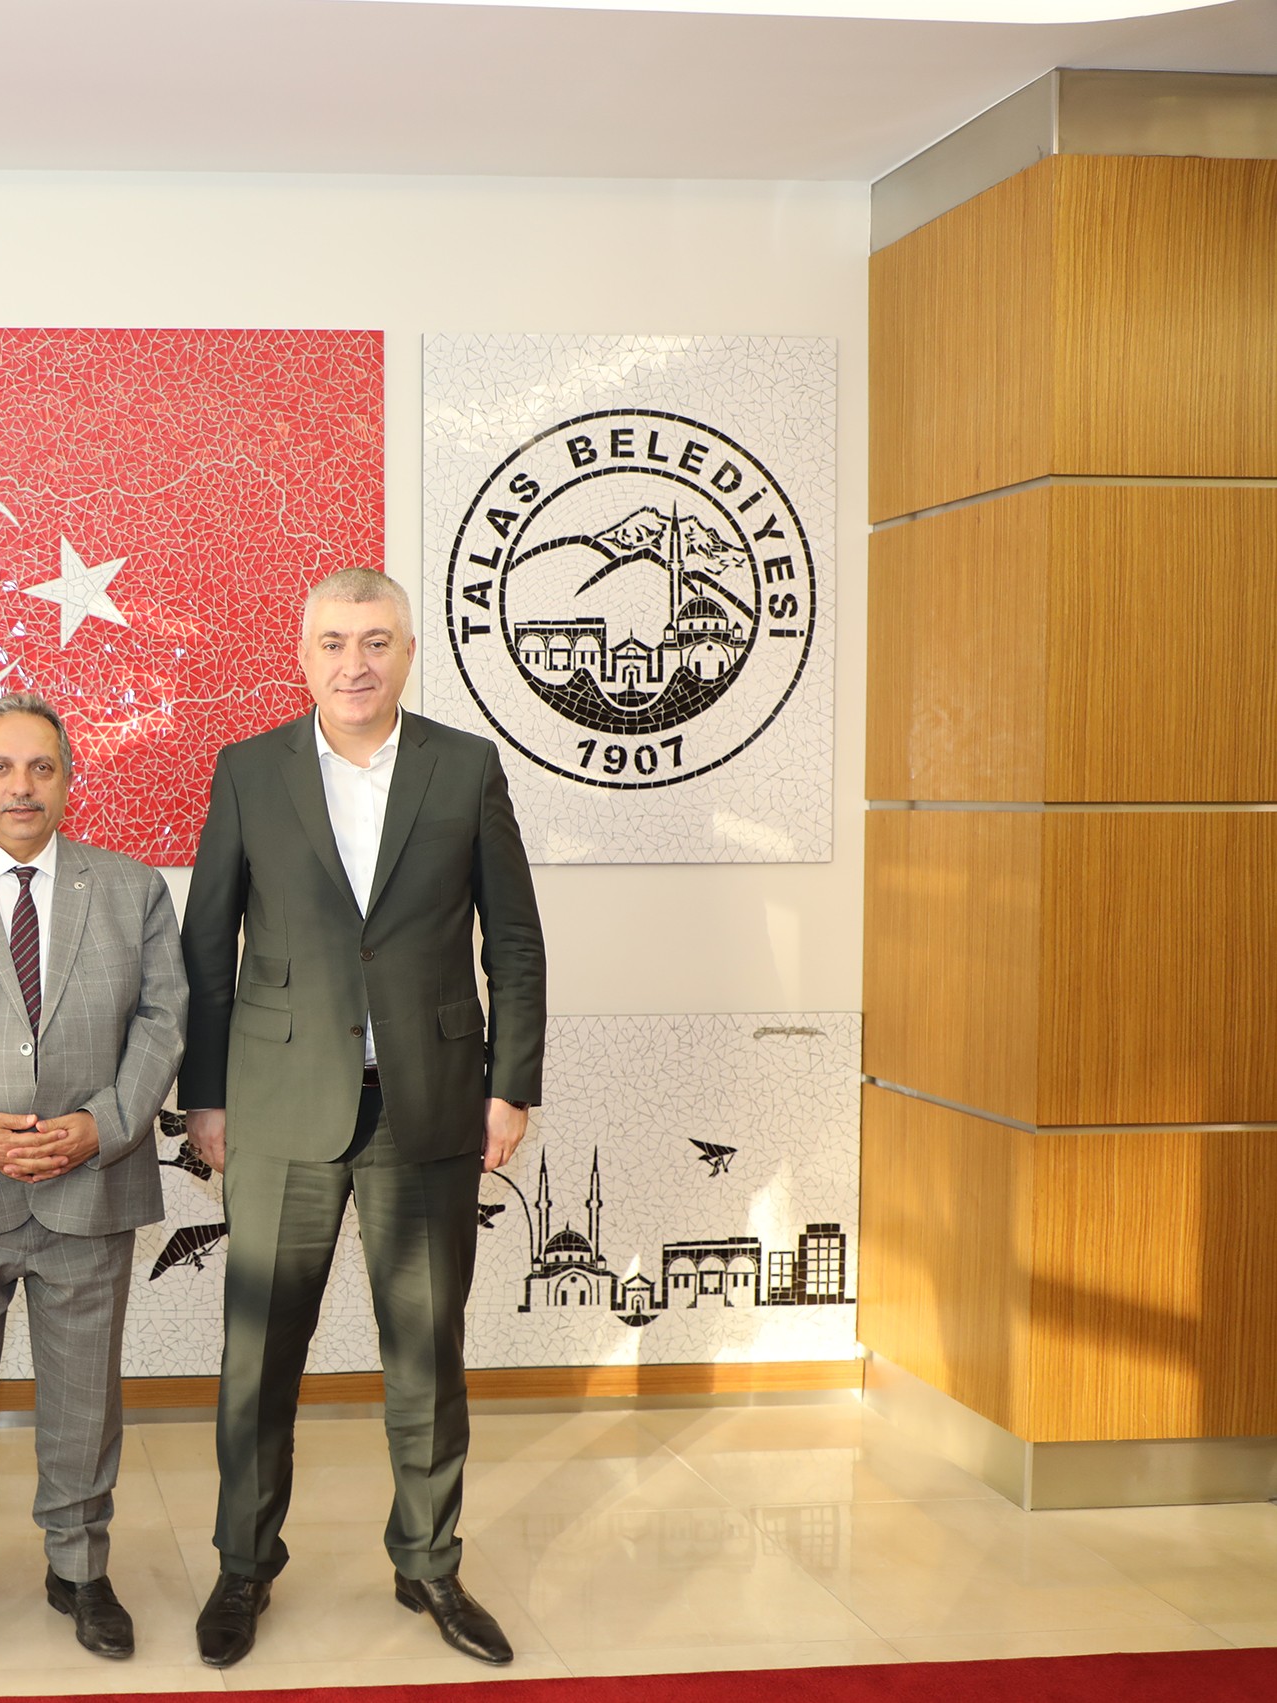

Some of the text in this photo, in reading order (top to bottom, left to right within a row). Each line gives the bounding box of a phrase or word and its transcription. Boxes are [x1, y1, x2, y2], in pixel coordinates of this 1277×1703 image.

[462, 428, 805, 644] TALAS BELEDİYESİ
[577, 735, 683, 775] 1907
